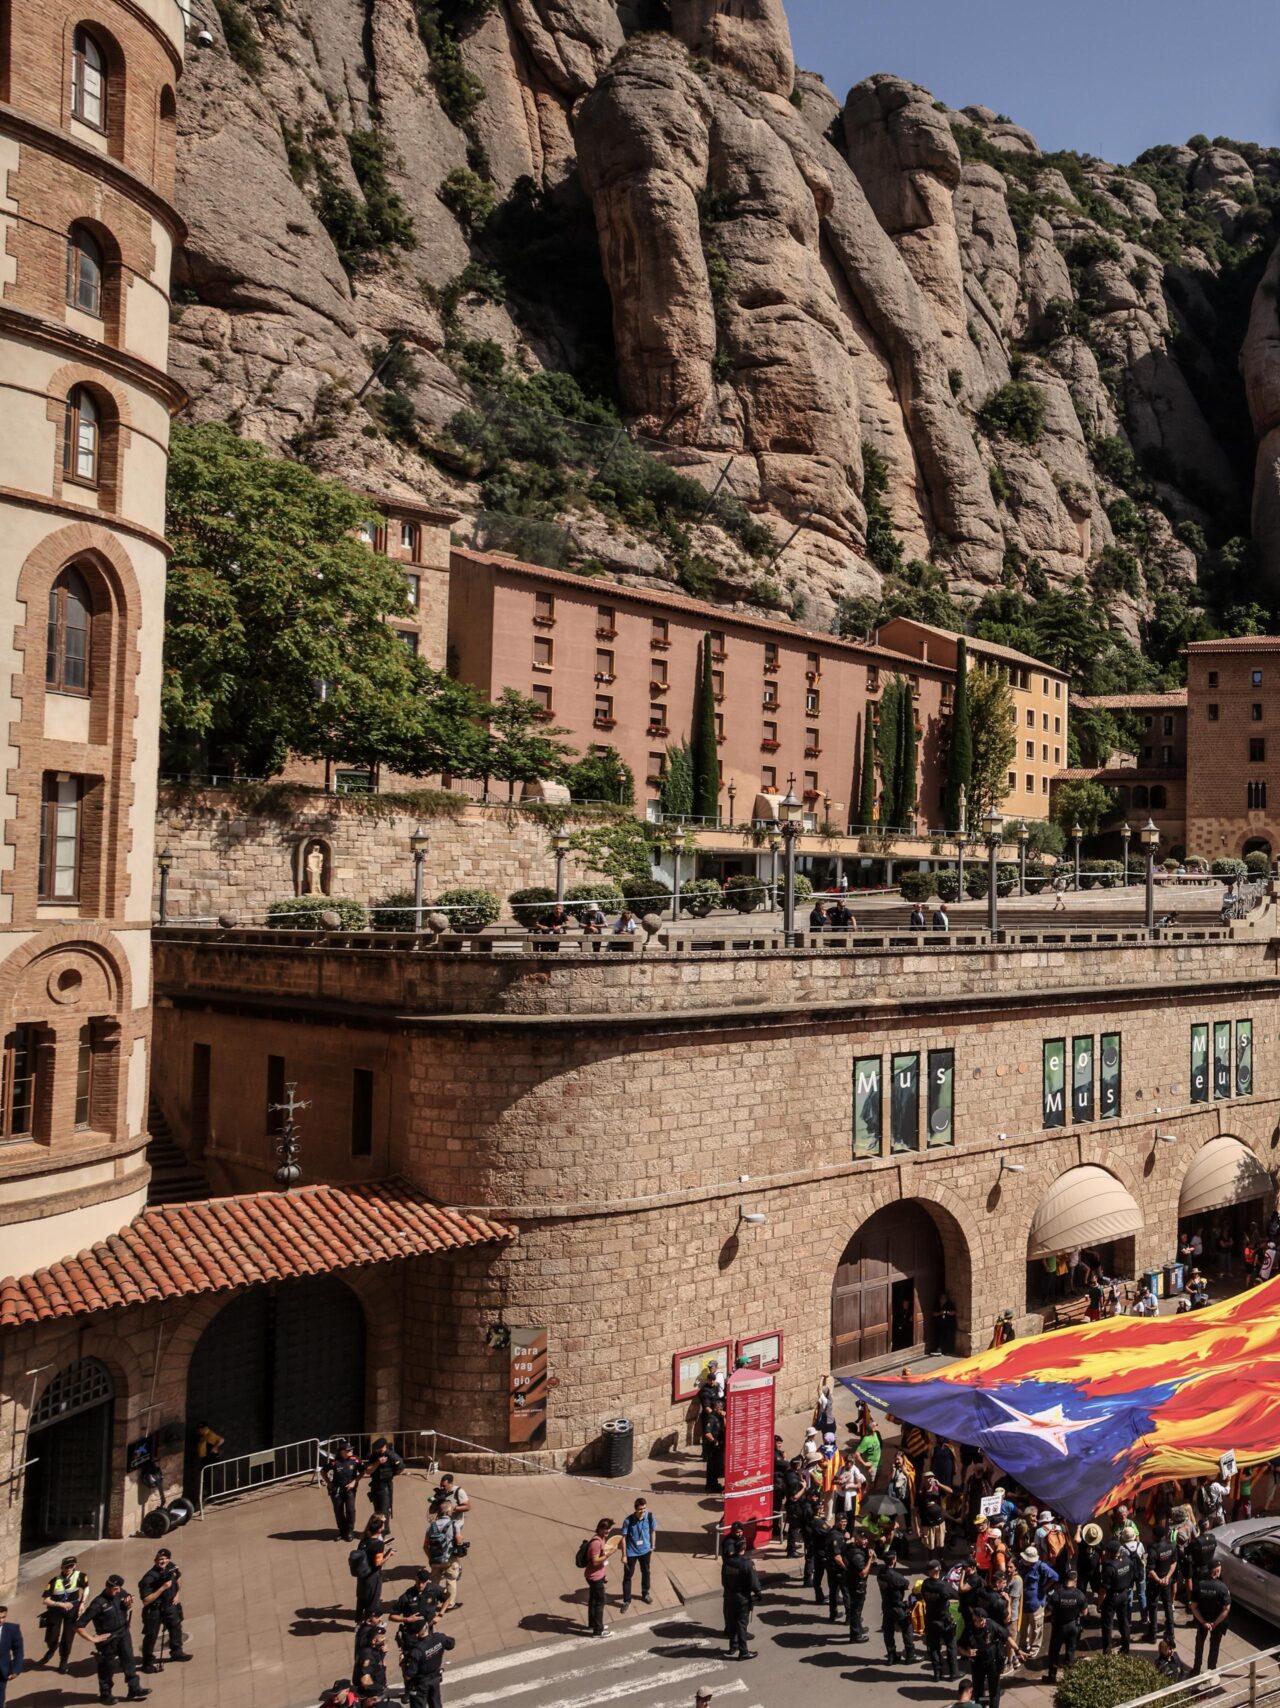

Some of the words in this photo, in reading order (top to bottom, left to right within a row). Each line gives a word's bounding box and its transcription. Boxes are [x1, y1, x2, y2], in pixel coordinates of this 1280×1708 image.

[1193, 1034, 1247, 1053] Mus
[857, 1067, 946, 1094] Mus
[1195, 1072, 1226, 1088] eu
[1046, 1089, 1114, 1113] Mus
[514, 1346, 538, 1356] Cara
[514, 1362, 533, 1371] vag
[513, 1376, 530, 1387] gio
